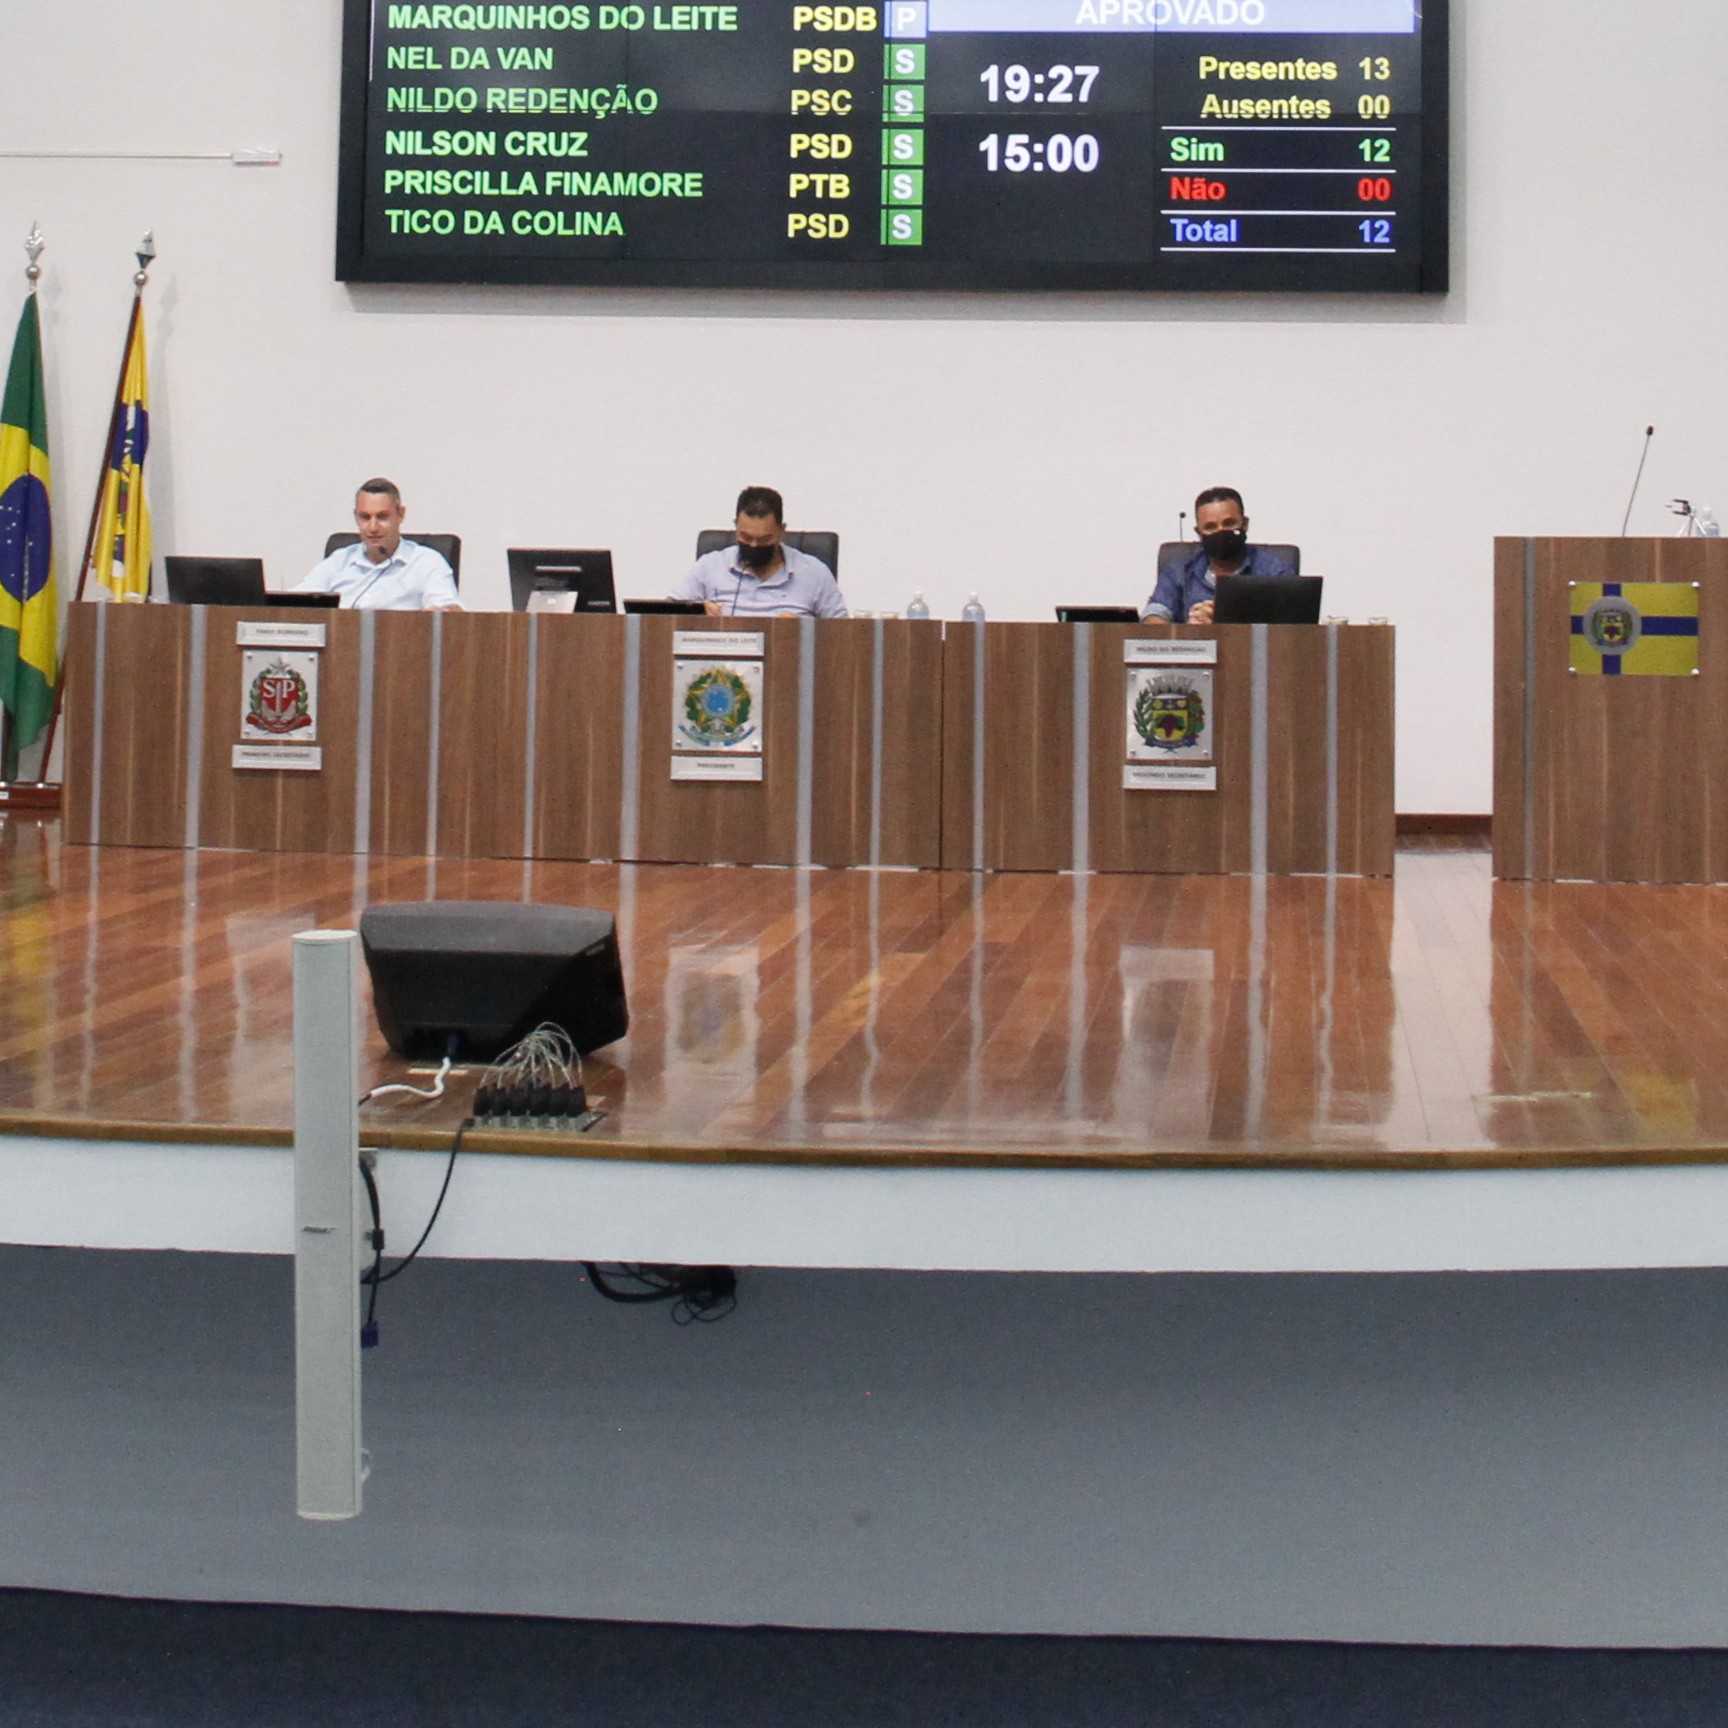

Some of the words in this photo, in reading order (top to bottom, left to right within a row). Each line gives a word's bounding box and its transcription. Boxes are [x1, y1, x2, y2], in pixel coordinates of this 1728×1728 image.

[389, 5, 591, 30] MARQUINHOS
[598, 6, 644, 30] DO
[654, 5, 738, 30] LEITE
[793, 7, 877, 32] PSDB
[898, 8, 915, 30] P
[387, 46, 442, 70] NEL
[451, 46, 490, 70] DA
[496, 46, 553, 70] VAN
[792, 49, 854, 73] PSD
[895, 49, 915, 73] S
[1200, 56, 1337, 81] Presentes
[1359, 57, 1390, 80] 13
[980, 65, 1100, 102] 19:27
[387, 88, 478, 112] NILDO
[487, 83, 658, 118] REDENÇÃO
[790, 89, 852, 114] PSC
[894, 90, 914, 115] S
[1202, 95, 1331, 118] Ausentes
[1358, 95, 1390, 118] 00
[386, 131, 495, 156] NILSON
[505, 132, 588, 156] CRUZ
[790, 134, 852, 158] PSD
[894, 134, 913, 158] S
[979, 134, 1099, 171] 15:00
[1171, 137, 1224, 162] Sim
[1359, 139, 1390, 162] 12
[385, 170, 537, 195] PRISCILLA
[546, 171, 703, 197] FINAMORE
[790, 173, 850, 198] PTB
[892, 174, 913, 198] S
[1170, 176, 1225, 200] Não
[1358, 177, 1390, 201] 00
[386, 209, 455, 234] TICO
[464, 210, 504, 234] DA
[512, 210, 624, 235] COLINA
[788, 213, 849, 237] PSD
[892, 214, 912, 238] S
[1171, 219, 1237, 242] Total
[1359, 220, 1390, 243] 12
